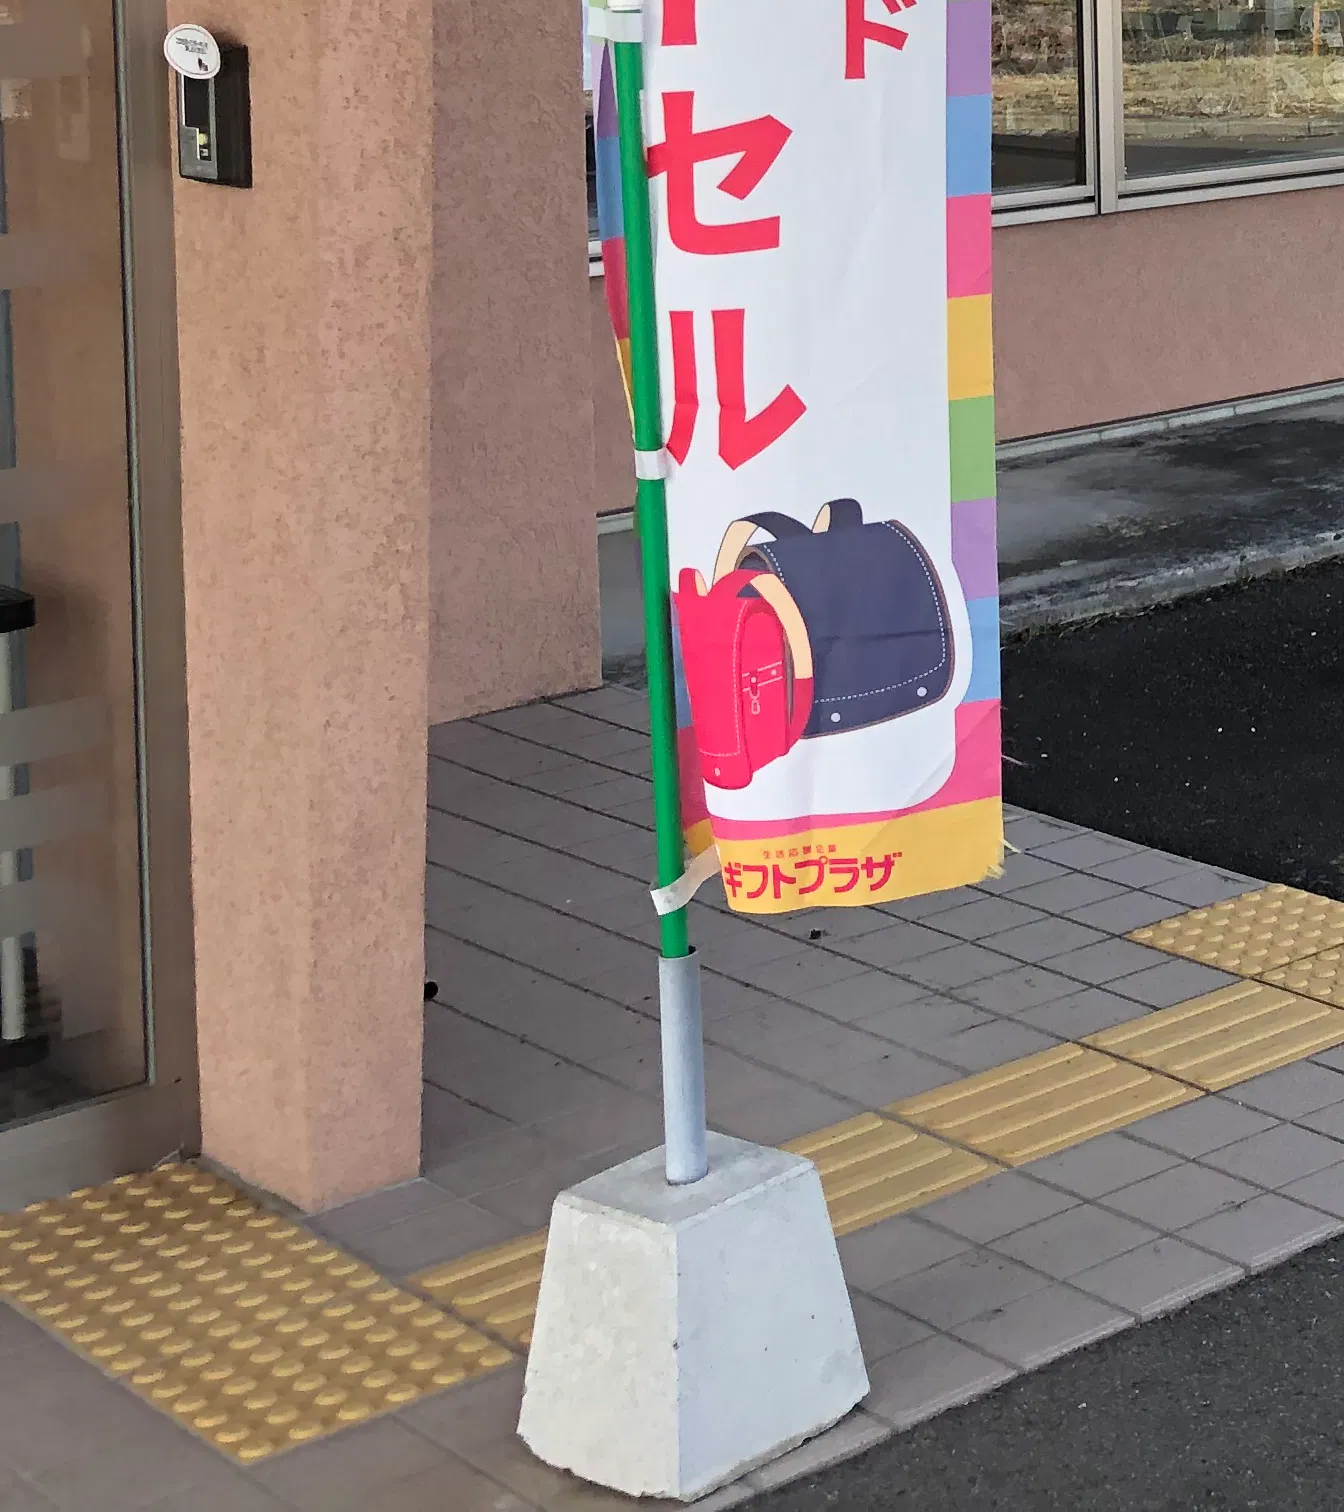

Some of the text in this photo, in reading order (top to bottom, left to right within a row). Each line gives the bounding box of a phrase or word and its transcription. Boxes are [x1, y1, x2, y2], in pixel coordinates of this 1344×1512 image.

[723, 851, 903, 900] ギフトプラザ
